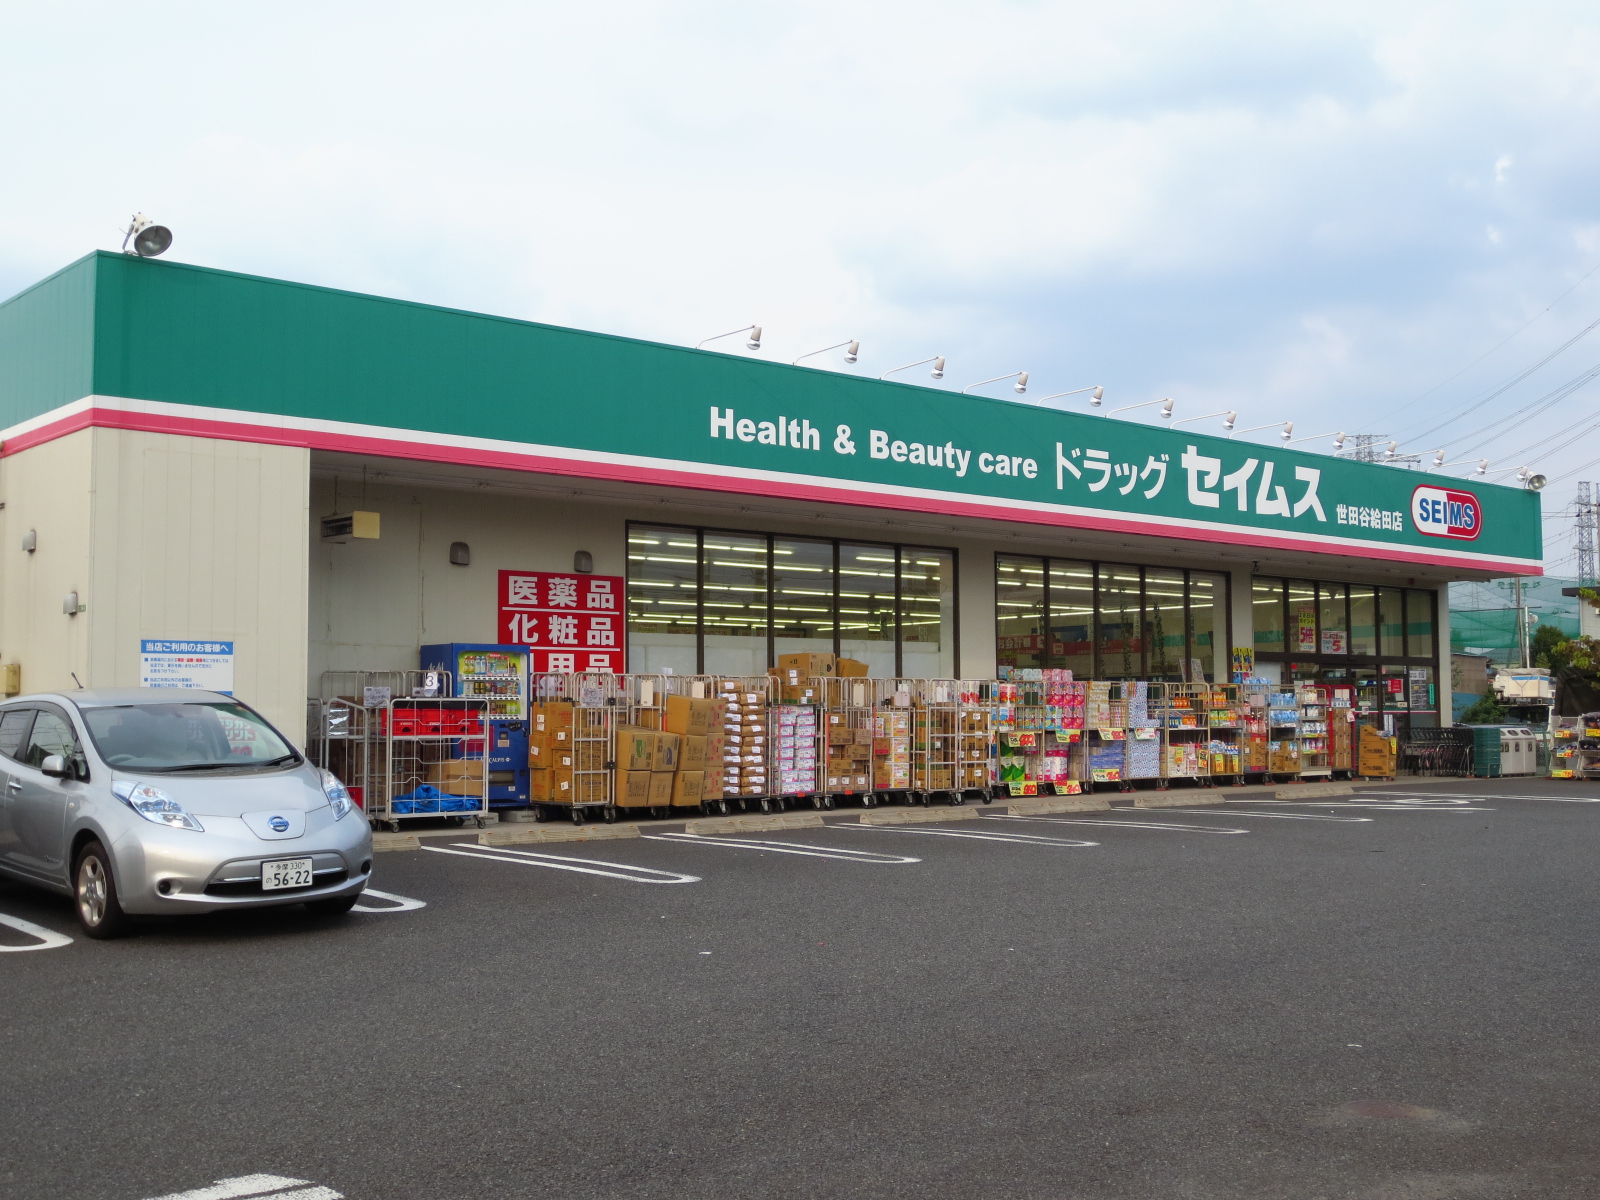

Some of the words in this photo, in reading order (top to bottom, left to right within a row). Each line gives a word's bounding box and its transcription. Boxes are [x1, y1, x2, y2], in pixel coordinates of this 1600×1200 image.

[710, 406, 820, 451] Health
[834, 424, 857, 457] &
[869, 429, 972, 478] Beauty
[978, 452, 1039, 479] care
[1056, 441, 1170, 500] ドラッグ
[1181, 444, 1327, 522] セイムス
[1336, 503, 1403, 532] 世田谷給田店
[1419, 498, 1475, 529] SEIMS
[508, 575, 615, 609] 医薬品
[508, 613, 615, 646] 化粧品
[145, 642, 229, 653] 当店ご利用のお客様へ
[425, 675, 434, 686] 3
[273, 869, 310, 887] 56-22
[290, 861, 303, 870] 330
